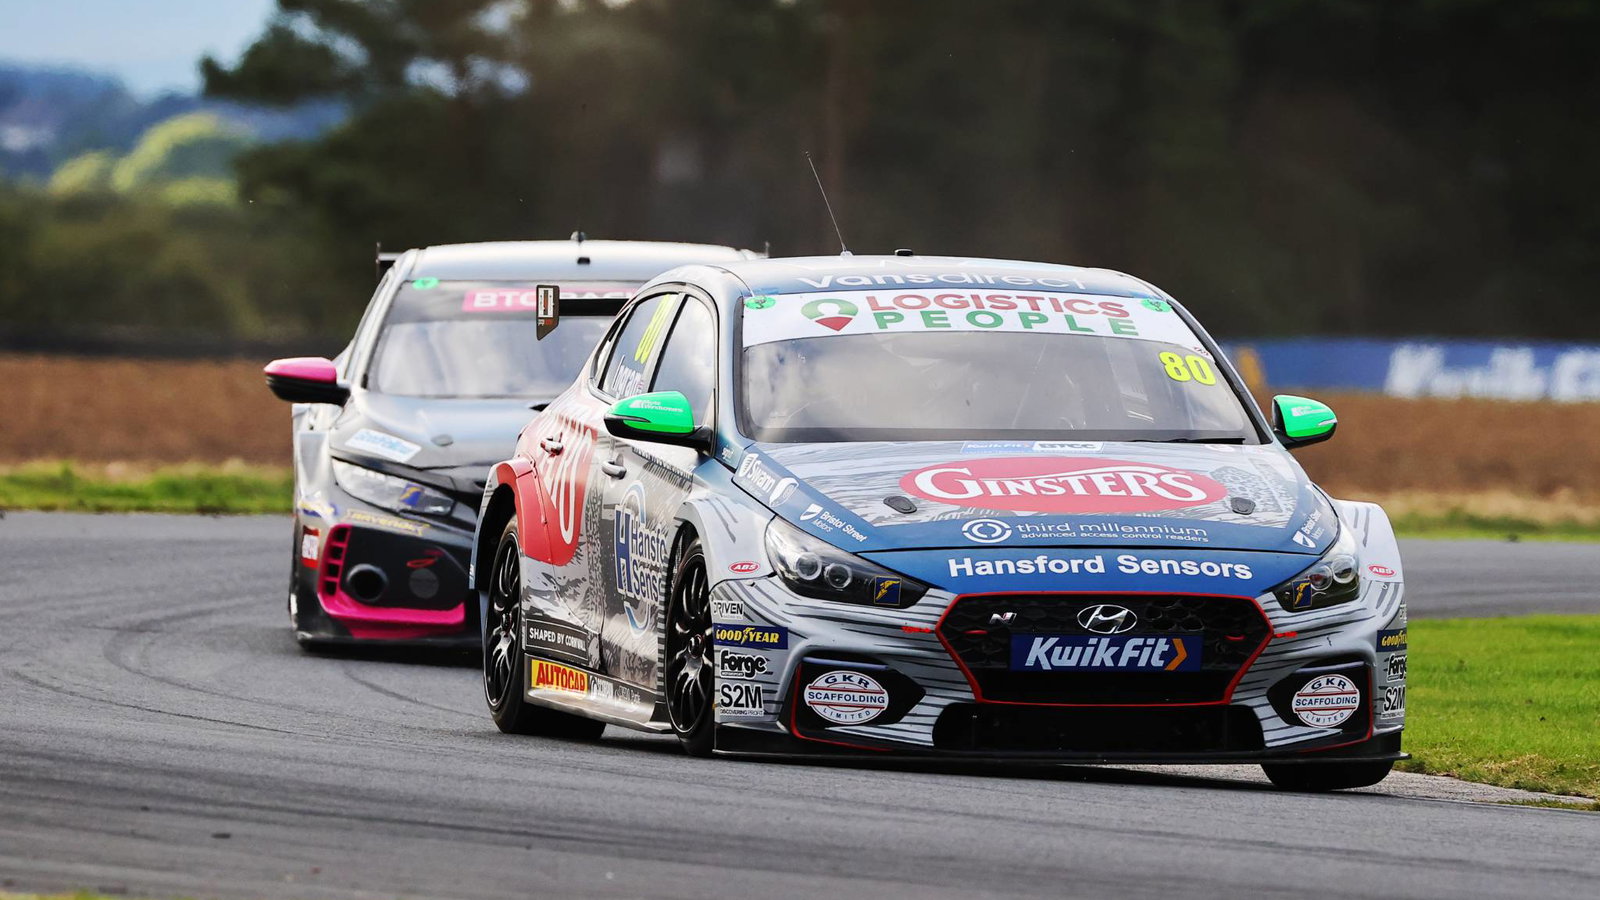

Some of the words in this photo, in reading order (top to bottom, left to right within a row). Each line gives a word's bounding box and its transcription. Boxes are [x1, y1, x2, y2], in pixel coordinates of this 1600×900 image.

[865, 293, 1131, 319] LOGISTICS
[876, 310, 1140, 336] PEOPLE
[1158, 351, 1217, 386] 80
[820, 511, 846, 529] Bristol
[842, 525, 868, 542] Street
[1015, 522, 1070, 533] third
[1079, 522, 1208, 537] millennium
[1021, 531, 1076, 539] advanced
[1122, 531, 1161, 539] control
[1165, 534, 1209, 543] readers
[732, 563, 757, 571] ABS
[948, 554, 1105, 577] Hansford
[1117, 554, 1253, 580] Sensors
[1371, 565, 1393, 575] ABS
[529, 627, 556, 641] SHAPED
[557, 633, 565, 645] BY
[824, 674, 870, 689] GKR
[1310, 677, 1347, 690] GKR
[720, 684, 763, 709] S2M
[808, 691, 885, 704] SCAFFOLDING
[1295, 696, 1357, 707] SCAFFOLDING
[823, 707, 871, 720] LIMITED
[1306, 711, 1345, 724] LIMITED
